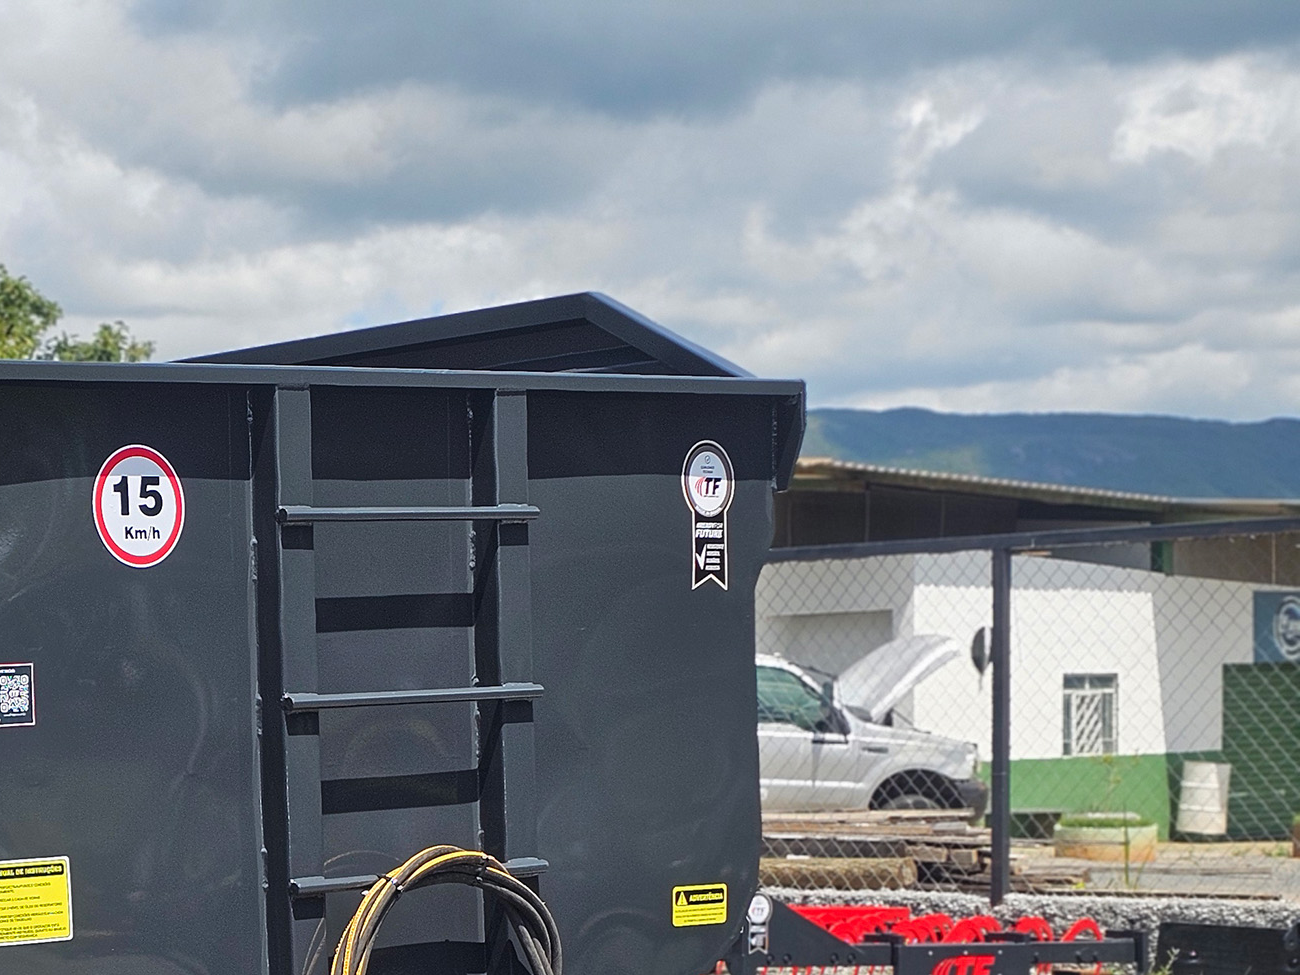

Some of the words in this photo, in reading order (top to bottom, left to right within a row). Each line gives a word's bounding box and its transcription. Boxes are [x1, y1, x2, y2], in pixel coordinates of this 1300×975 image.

[704, 477, 722, 495] TF
[113, 476, 163, 517] 15
[124, 526, 160, 541] Km/h
